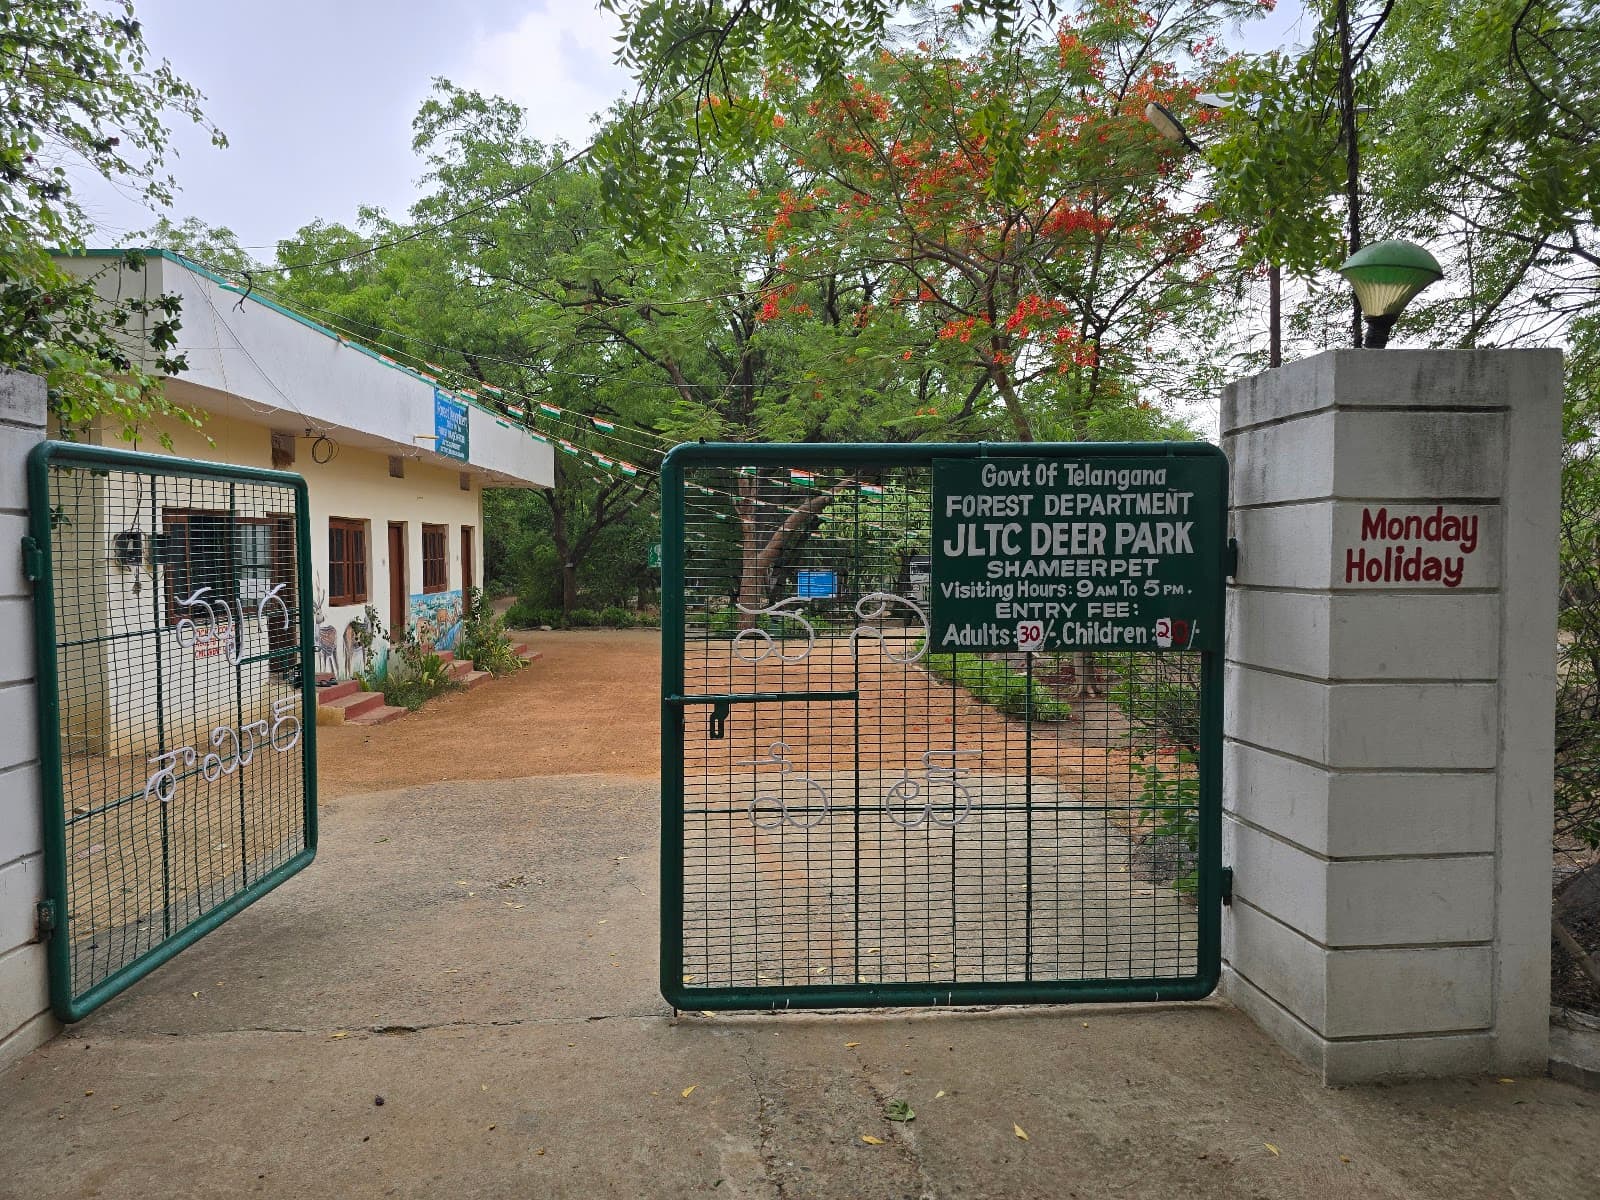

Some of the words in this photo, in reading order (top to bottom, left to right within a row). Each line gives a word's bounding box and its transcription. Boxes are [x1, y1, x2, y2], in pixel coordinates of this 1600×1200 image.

[981, 463, 1031, 488] Govt
[1035, 463, 1058, 487] Of
[1063, 463, 1167, 491] Telangana
[945, 494, 1034, 518] FOREST
[1044, 491, 1194, 516] DEPARTMENT
[943, 522, 1023, 557] JLTC
[1030, 522, 1107, 556] DEER
[1114, 521, 1194, 555] PARK
[1361, 506, 1478, 554] Monday
[986, 558, 1160, 579] SHAMEERPET
[1345, 545, 1464, 588] Holiday
[940, 580, 1014, 601] Visiting
[1017, 581, 1073, 598] Hours:
[1119, 580, 1138, 597] To
[995, 602, 1077, 619] ENTRY
[1087, 602, 1139, 618] FEE:
